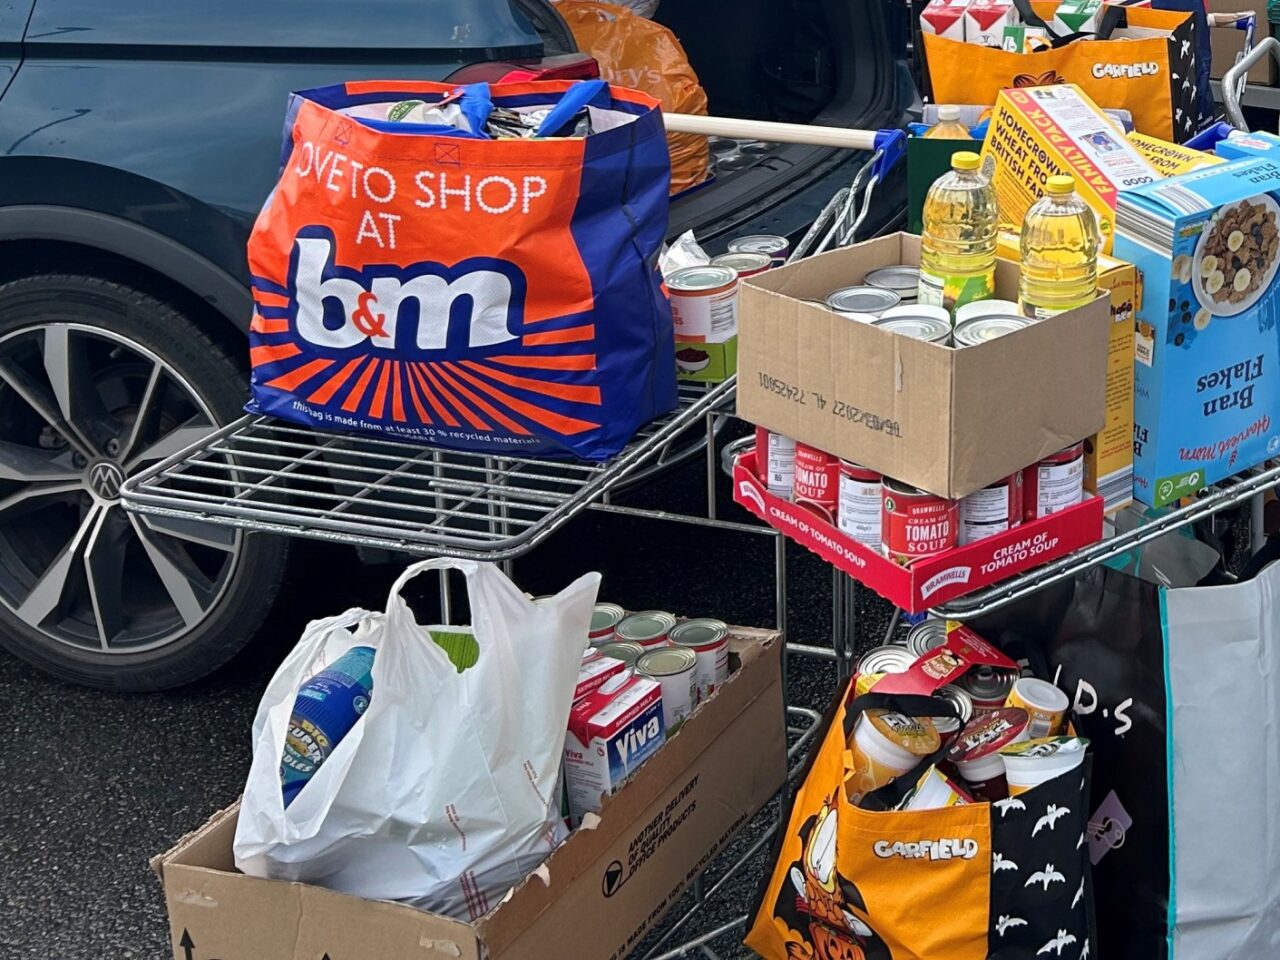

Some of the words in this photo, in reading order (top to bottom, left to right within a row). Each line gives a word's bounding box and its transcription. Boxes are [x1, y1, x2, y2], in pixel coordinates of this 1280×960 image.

[1091, 61, 1160, 80] GARFIELD
[995, 120, 1028, 162] WHEAT
[1027, 109, 1063, 142] PACK
[990, 135, 1026, 180] BRITISH
[1060, 141, 1115, 194] FAMILY
[1150, 156, 1179, 170] FROM
[1231, 161, 1280, 179] Flakes
[350, 160, 396, 204] TO
[415, 170, 548, 214] SHOP
[355, 210, 401, 249] AT
[295, 236, 521, 351] b&m
[1196, 354, 1266, 393] Flakes
[1203, 384, 1256, 417] Bran
[324, 411, 333, 421] is
[334, 414, 358, 428] made
[359, 419, 382, 432] from
[384, 424, 395, 432] at
[396, 425, 420, 436] least
[422, 427, 435, 436] 30
[436, 429, 448, 438] %
[449, 431, 491, 442] recycled
[1217, 413, 1272, 460] Harvest
[907, 517, 938, 525] CREAM
[911, 503, 945, 516] BRAMWELLS
[770, 507, 799, 526] CREAM
[798, 522, 811, 534] OF
[810, 528, 845, 556] TOMATO
[844, 549, 867, 569] SOUP
[905, 521, 950, 542] TOMATO
[907, 538, 948, 553] SOUP
[993, 538, 1032, 561] CREAM
[1032, 531, 1050, 544] OF
[980, 550, 1028, 576] TOMATO
[1029, 537, 1060, 557] SOUP
[925, 570, 967, 593] BRAMWELLS
[615, 704, 641, 728] SKIMMED
[640, 695, 654, 710] MILK
[288, 723, 323, 764] SUPER
[301, 719, 330, 748] BIG
[615, 715, 661, 775] Viva
[565, 748, 583, 760] Viva
[629, 812, 664, 856] ANOTHER
[663, 773, 700, 816] DELIVERY
[628, 849, 640, 867] OF
[640, 817, 673, 853] QUALITY
[629, 845, 657, 877] OFFICE
[657, 799, 698, 849] PRODUCTS
[872, 836, 979, 862] GARFIELD
[617, 943, 626, 957] IS
[627, 921, 648, 951] MADE
[648, 899, 668, 926] FROM
[685, 844, 719, 882] RECYCLED
[718, 811, 750, 846] MATERIAL
